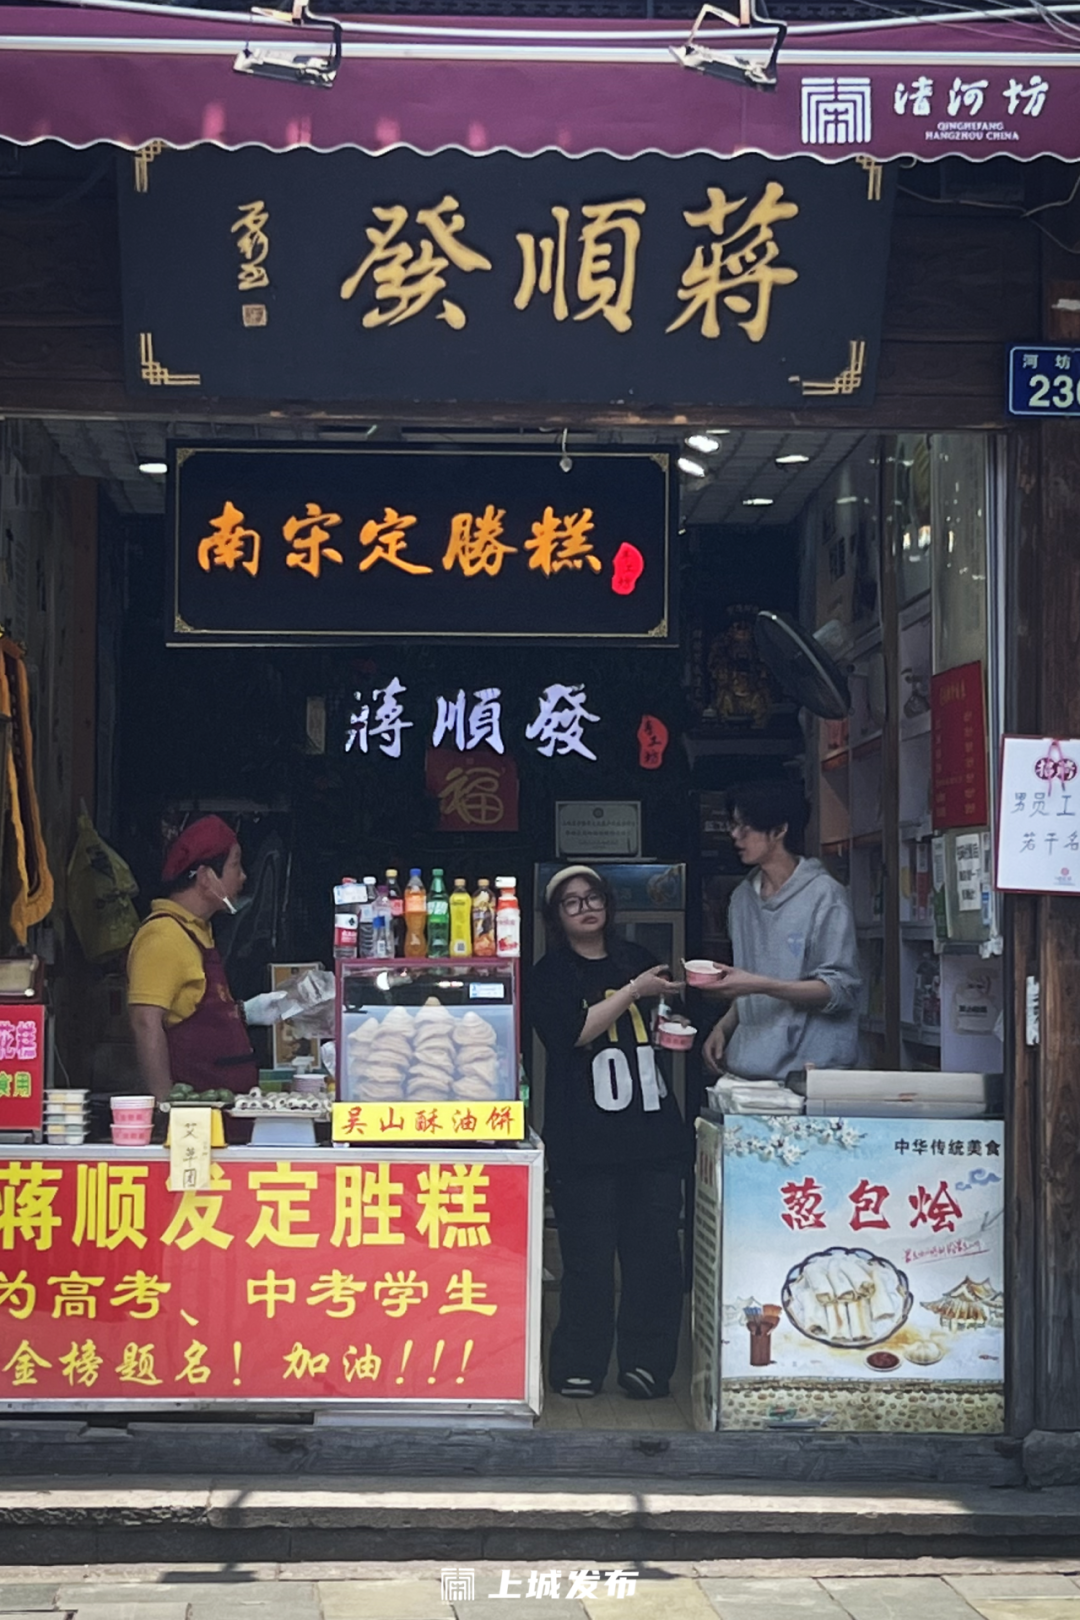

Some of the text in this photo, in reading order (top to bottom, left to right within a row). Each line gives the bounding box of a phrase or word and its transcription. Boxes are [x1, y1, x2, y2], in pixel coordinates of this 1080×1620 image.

[925, 131, 1019, 141] HANGZHOU CHINA
[937, 121, 1004, 131] QINGHEFANG
[1029, 374, 1080, 408] 23
[1011, 792, 1075, 817] 男员工
[342, 1106, 515, 1135] 吴山酥油饼
[895, 1138, 1001, 1156] 中华传统美食
[0, 1161, 492, 1250] 蒋顺发定胜糕
[779, 1176, 963, 1233] 葱包烩
